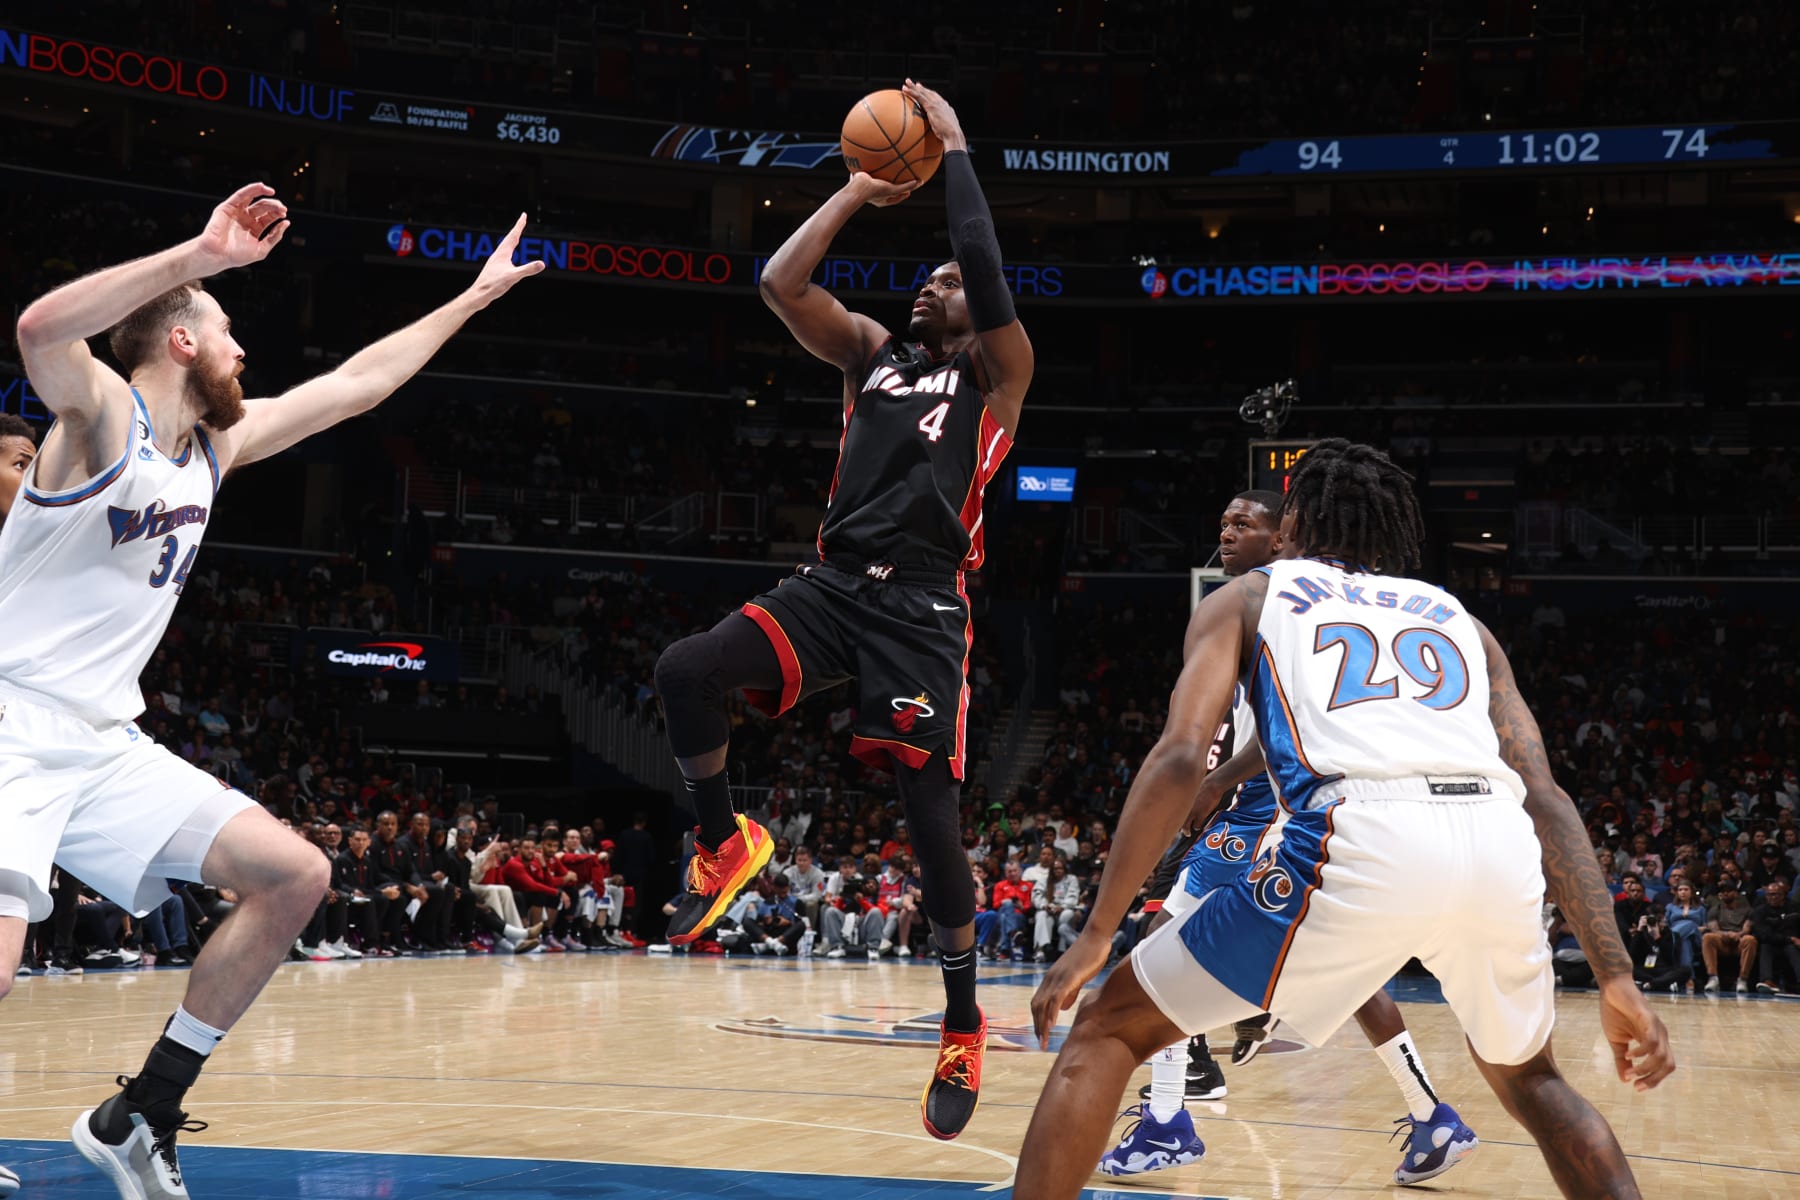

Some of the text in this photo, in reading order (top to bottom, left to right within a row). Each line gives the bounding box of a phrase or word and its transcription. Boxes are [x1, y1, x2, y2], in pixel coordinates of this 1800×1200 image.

[406, 116, 469, 131] 50/50 RAFFLE
[407, 105, 468, 121] FOUNDATION
[503, 112, 547, 125] JACKPOT
[497, 121, 560, 144] $6,430
[1498, 131, 1600, 165] 11:02
[1661, 127, 1709, 159] 74
[1002, 148, 1171, 173] WASHINGTON
[1297, 139, 1343, 171] 94
[1442, 150, 1455, 166] 4
[753, 255, 880, 290] IRY
[918, 401, 952, 443] 4
[149, 534, 199, 597] 34
[1313, 621, 1470, 712] 29
